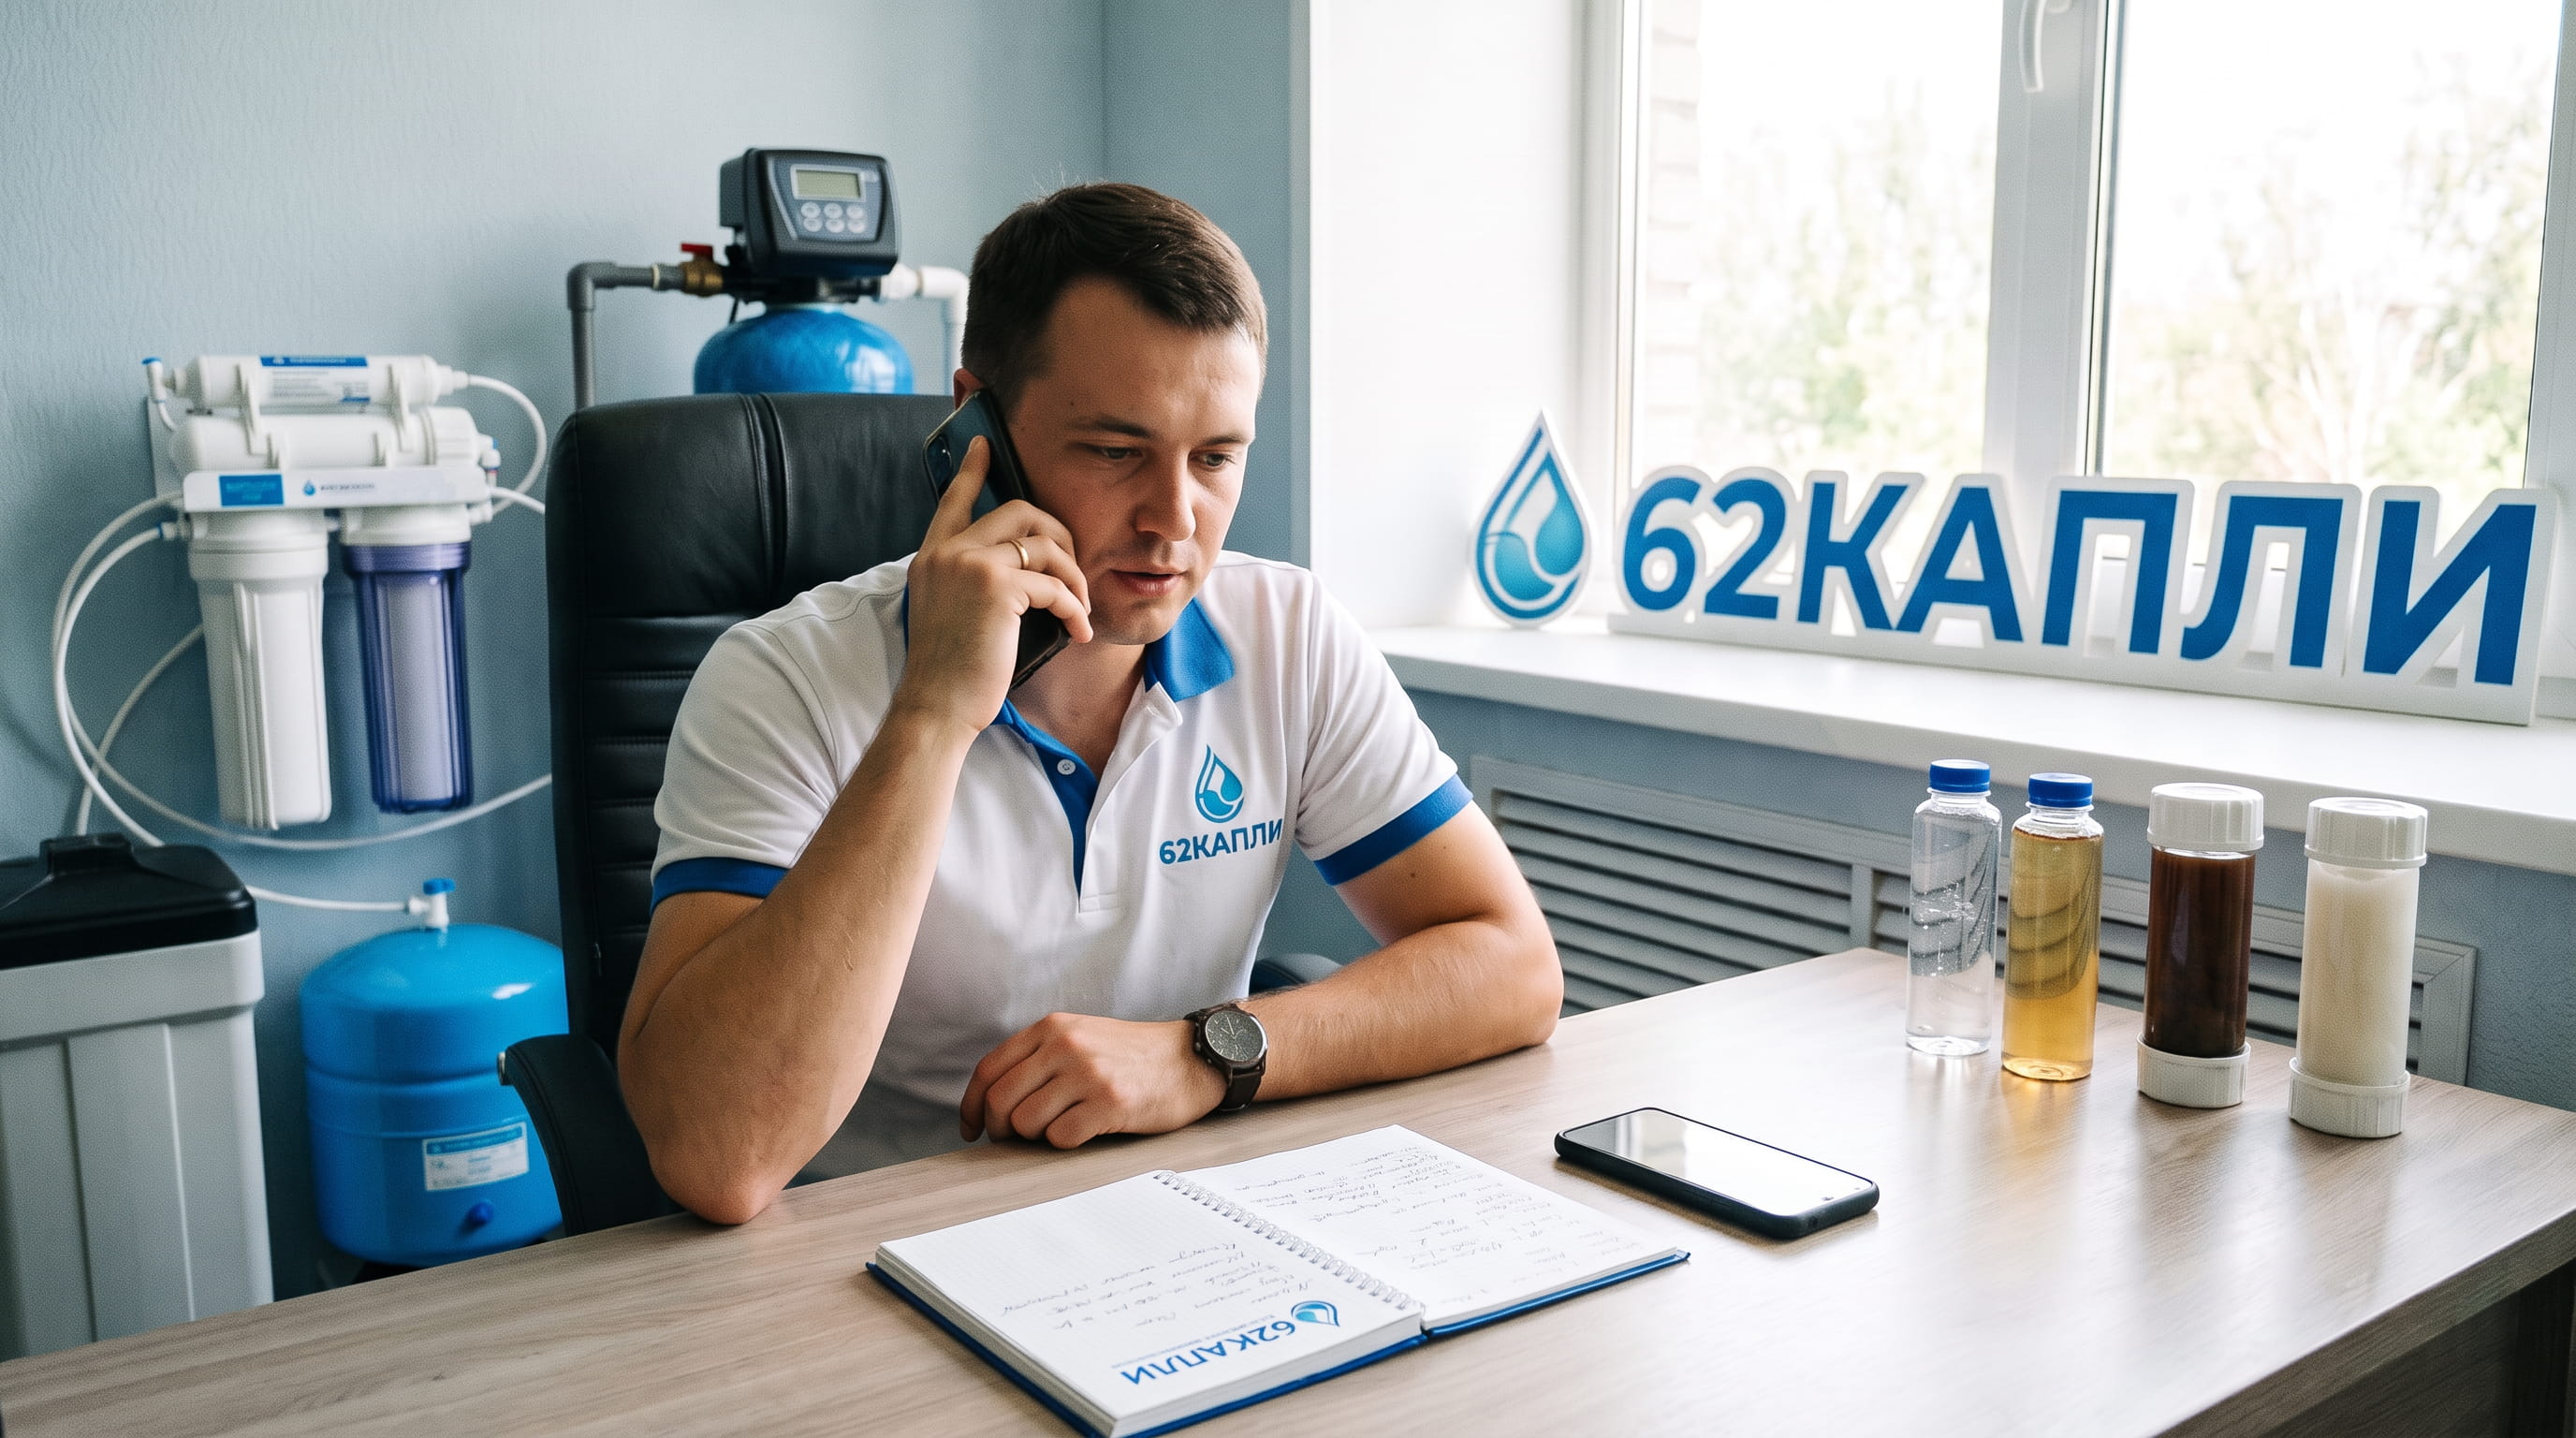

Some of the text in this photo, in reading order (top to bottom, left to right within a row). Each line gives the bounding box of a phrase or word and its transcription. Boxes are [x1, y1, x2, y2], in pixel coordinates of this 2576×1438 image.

[1621, 476, 2538, 686] 62КАПЛИ
[1159, 818, 1282, 864] 62КАПЛИ
[1120, 1320, 1296, 1385] 62КАПЛИ
